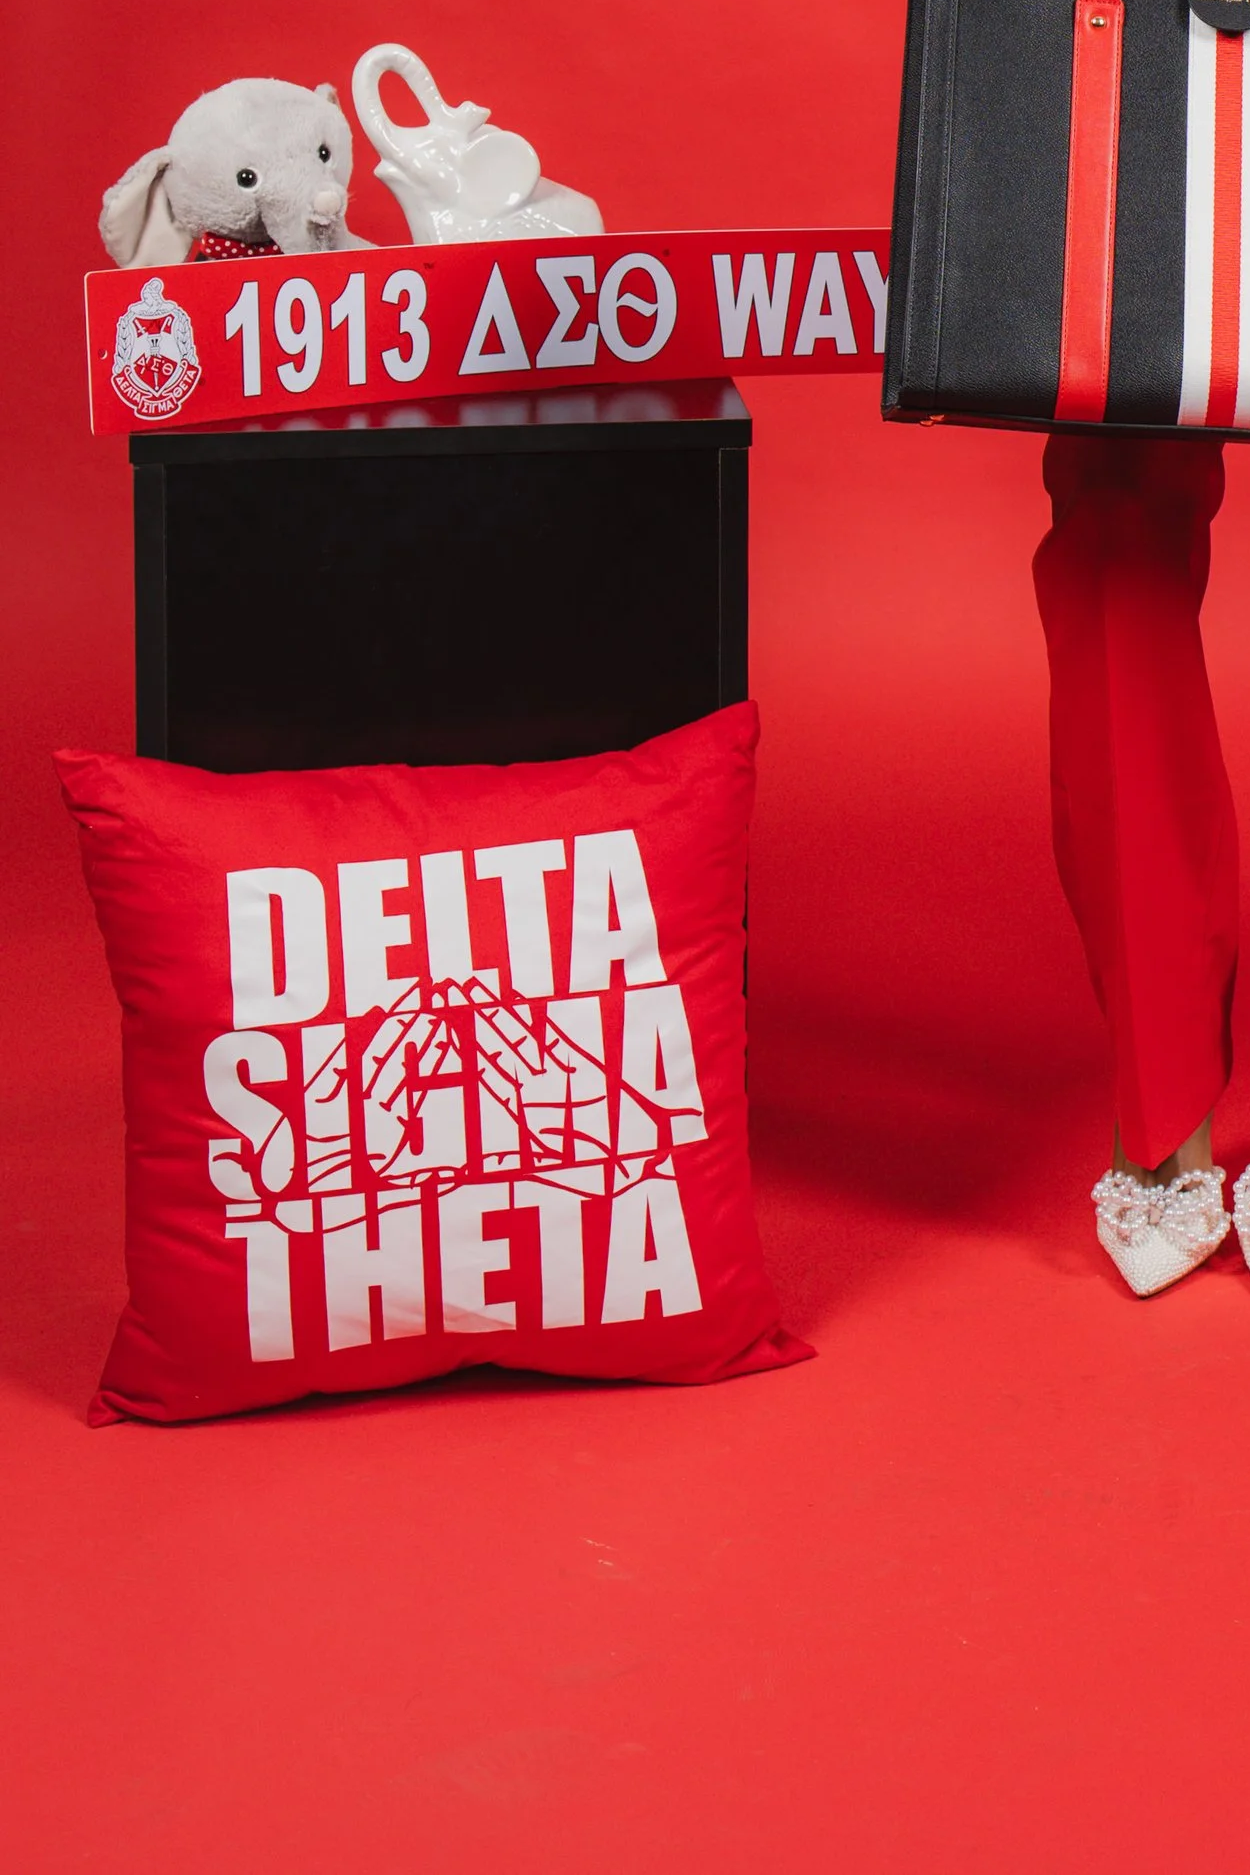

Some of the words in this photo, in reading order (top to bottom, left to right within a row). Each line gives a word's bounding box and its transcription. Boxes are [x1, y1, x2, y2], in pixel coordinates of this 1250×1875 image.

[224, 270, 430, 397] 1913
[458, 252, 677, 376] ΔΣΘ
[227, 829, 668, 1030] DELTA
[202, 983, 709, 1201] SIGMA
[225, 1157, 703, 1363] THETA
